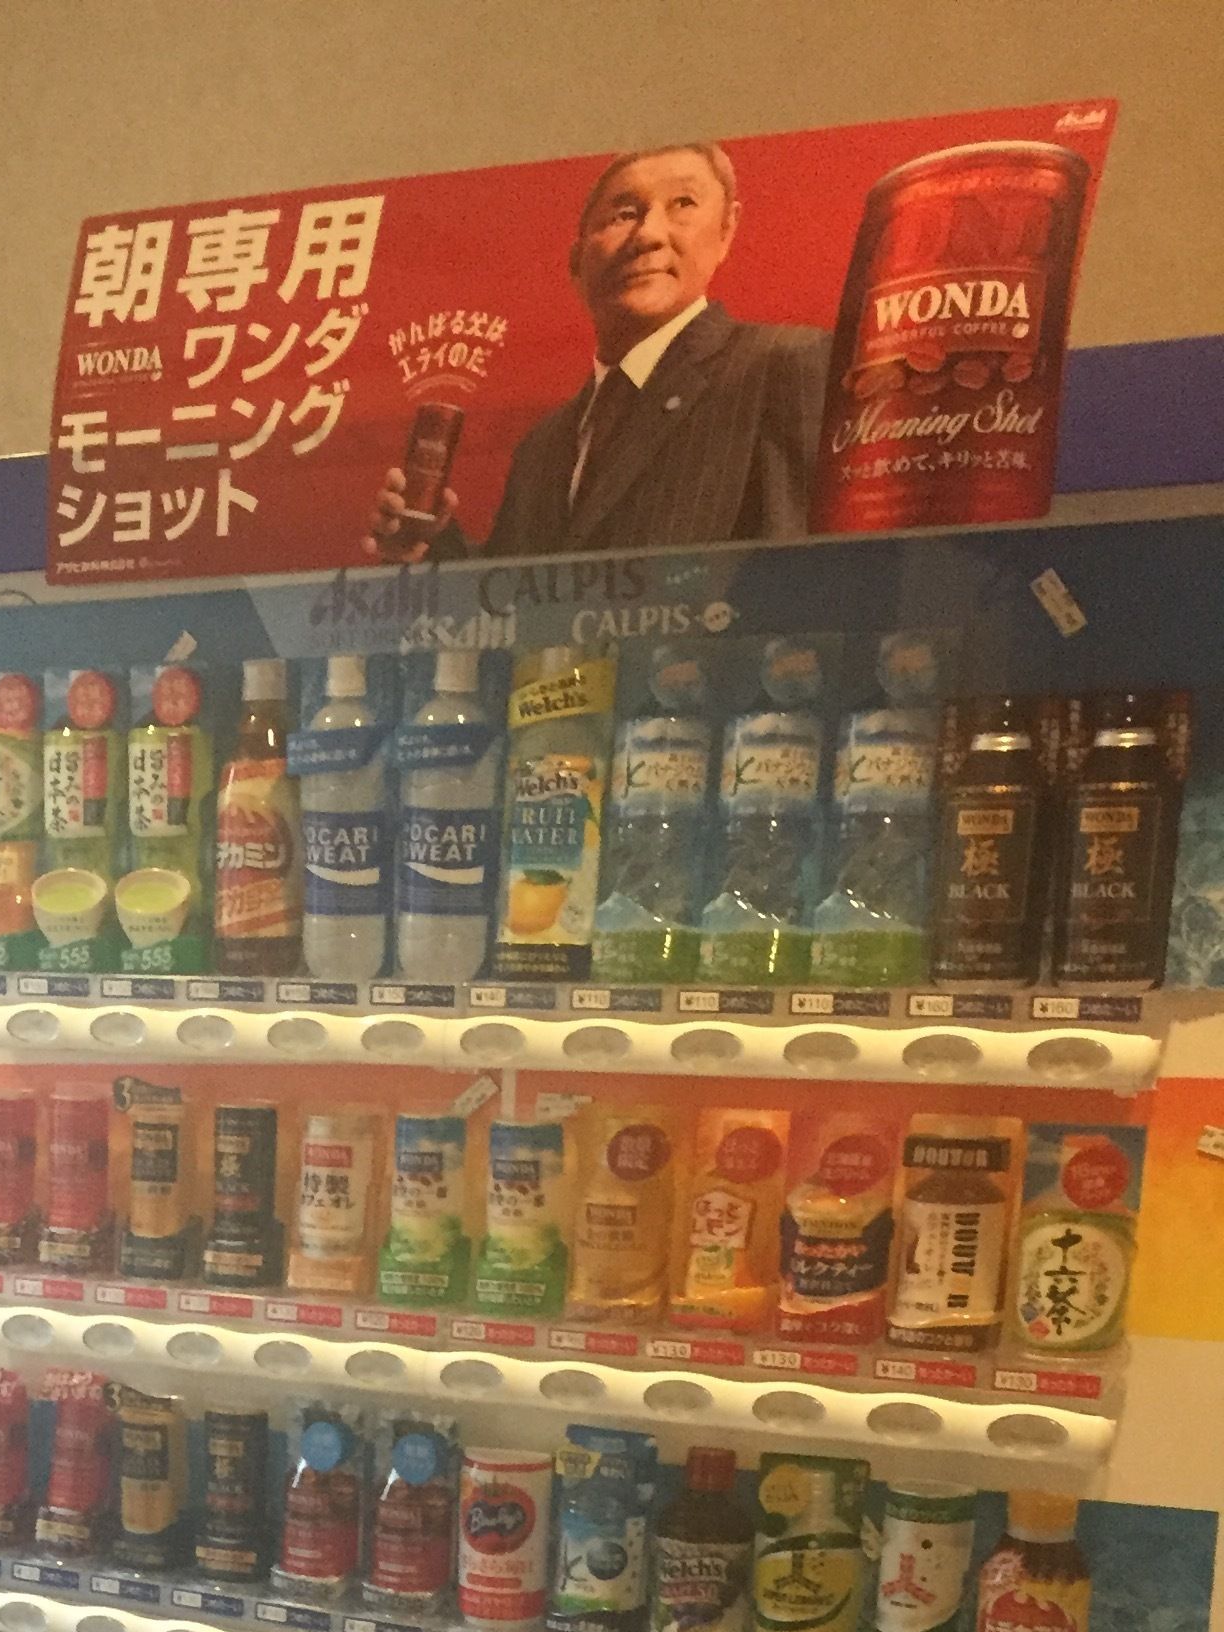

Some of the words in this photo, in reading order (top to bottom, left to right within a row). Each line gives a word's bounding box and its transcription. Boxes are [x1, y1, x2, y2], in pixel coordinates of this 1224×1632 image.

[74, 195, 385, 327] 朝専用
[874, 280, 1031, 333] WONDA
[77, 346, 163, 377] WONDA
[182, 303, 369, 389] ワンダ
[57, 379, 350, 474] モーニング
[831, 398, 972, 455] Morning
[972, 388, 1044, 435] Shot
[56, 467, 259, 548] ショット
[573, 603, 693, 644] CALPIS
[947, 882, 1011, 900] BLACK
[1070, 882, 1136, 900] BLACK
[1043, 1228, 1088, 1336] 十六茶
[759, 1352, 797, 1367] ¥130
